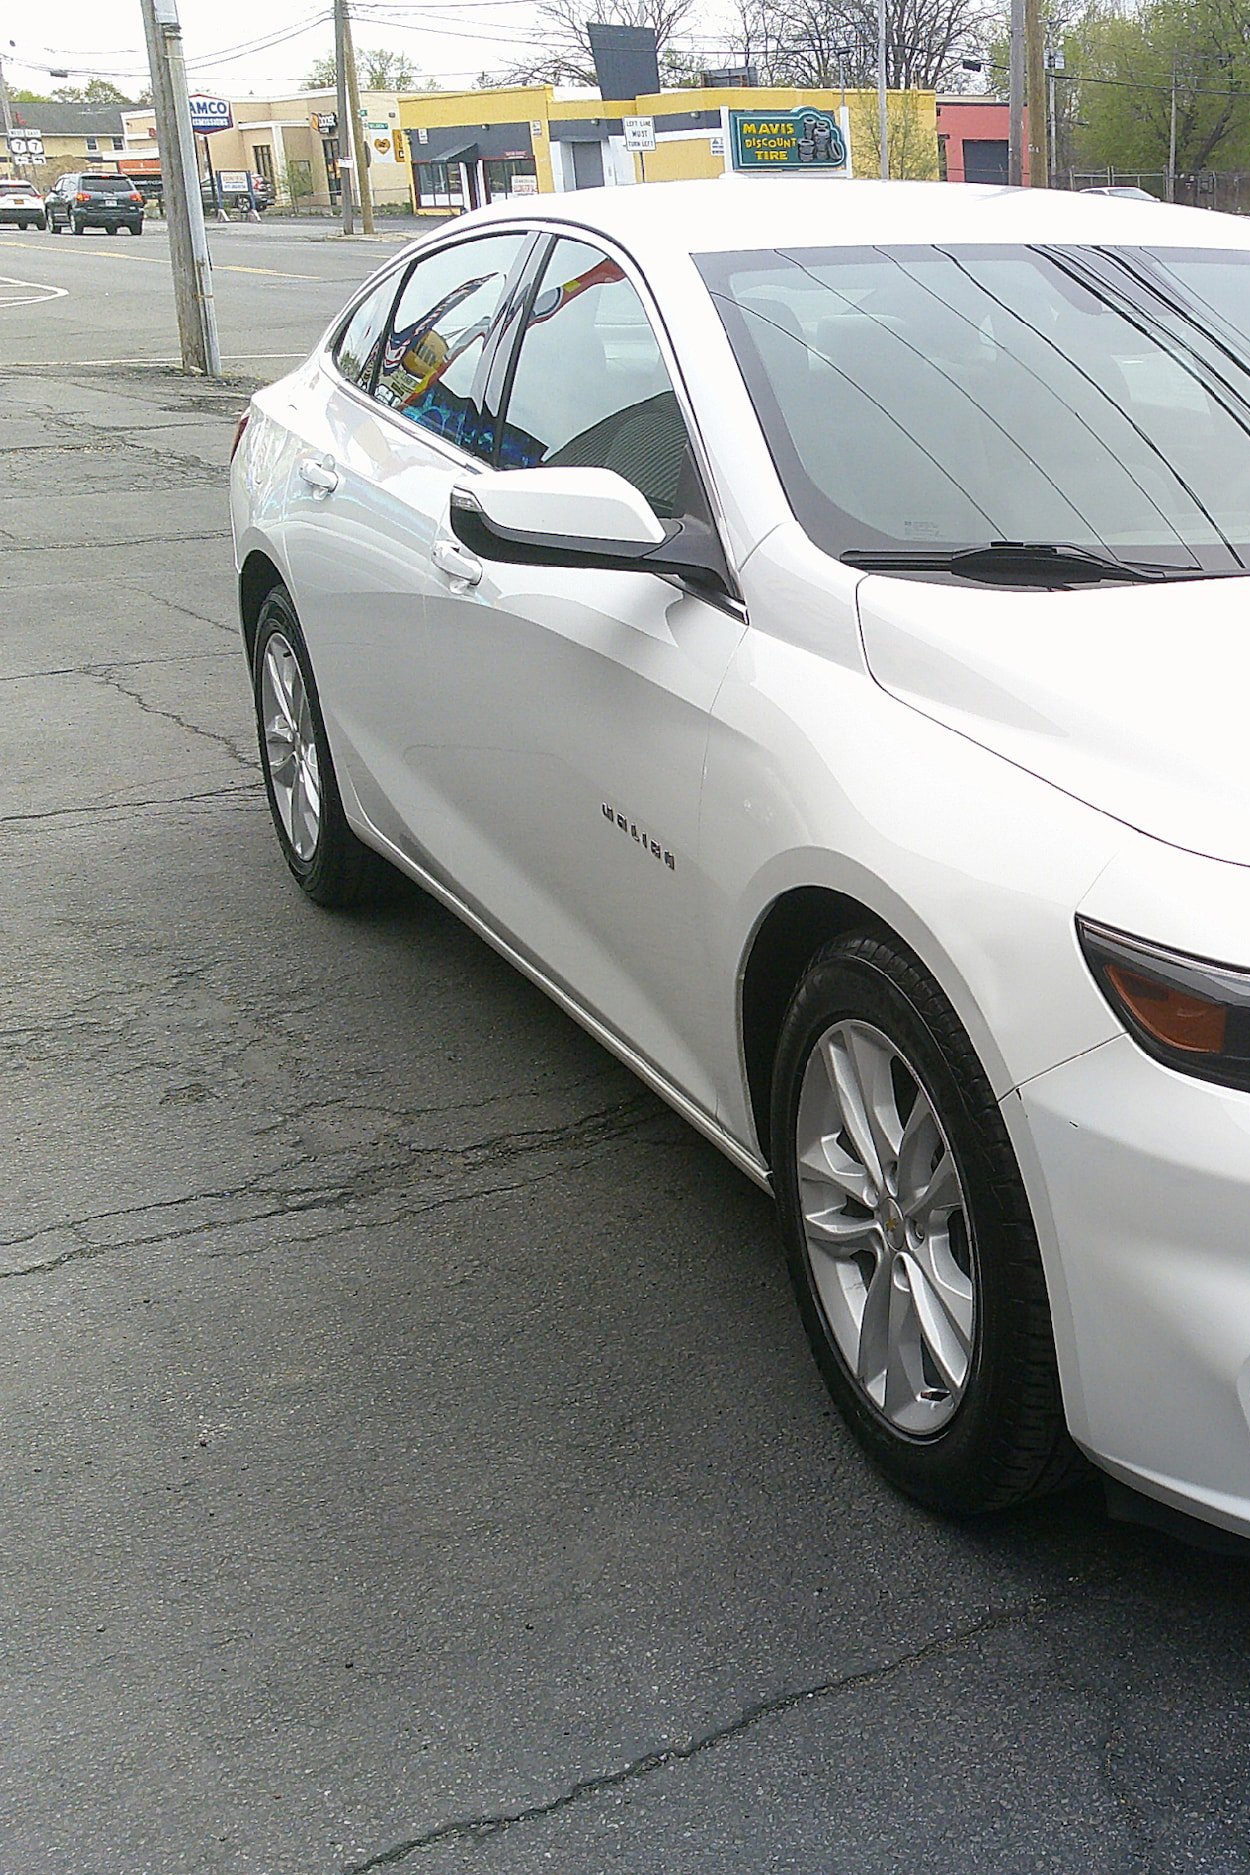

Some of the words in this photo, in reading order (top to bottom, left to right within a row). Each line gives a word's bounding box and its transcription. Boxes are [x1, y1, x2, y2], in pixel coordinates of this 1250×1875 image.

[632, 130, 648, 138] MUST
[743, 123, 795, 135] MAVIS
[745, 138, 796, 148] DISCOUNT
[755, 150, 788, 160] TIRE
[602, 802, 675, 871] MALIBU
